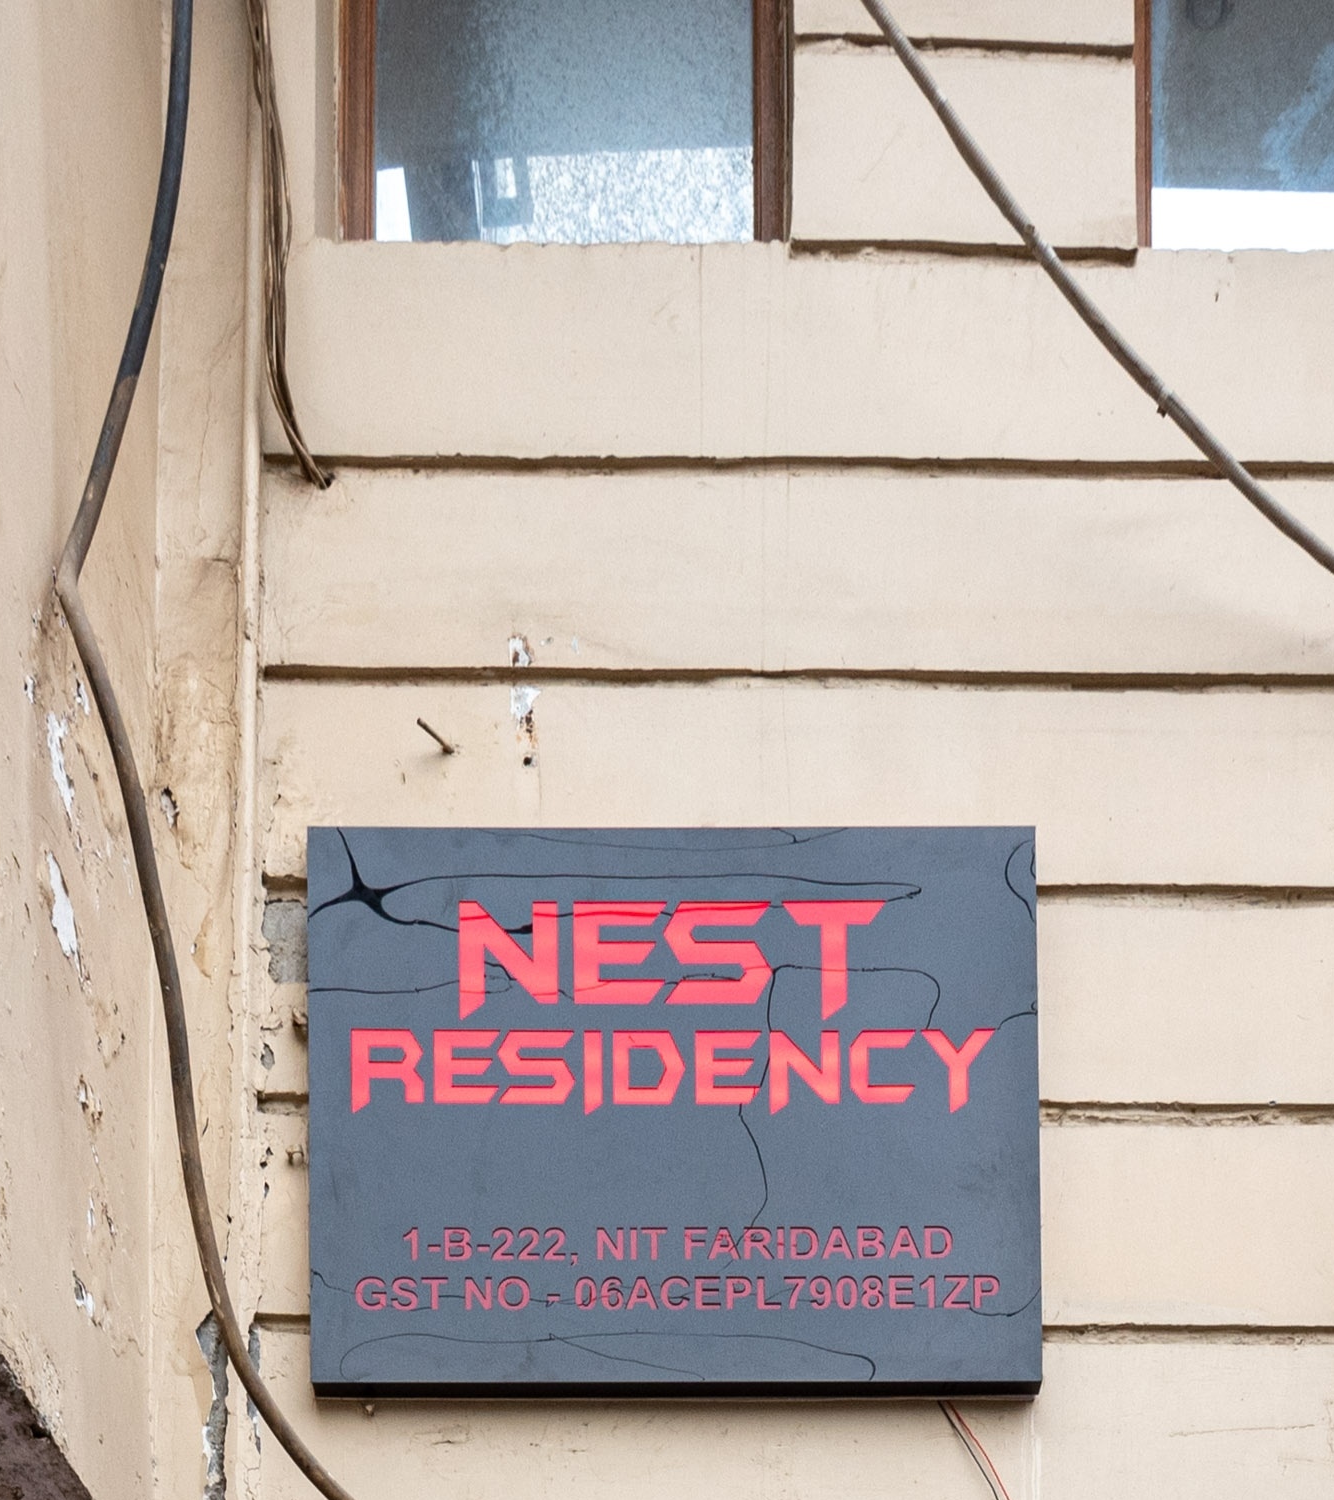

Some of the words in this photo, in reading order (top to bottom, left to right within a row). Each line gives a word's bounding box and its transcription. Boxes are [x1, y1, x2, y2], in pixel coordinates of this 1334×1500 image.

[457, 899, 888, 1021] NEST
[350, 1027, 997, 1116] RESIDENCY
[402, 1226, 579, 1266] 1-B-222,
[596, 1226, 668, 1261] NIT
[683, 1225, 955, 1261] FARIDABAD
[354, 1276, 449, 1311] GST
[464, 1276, 531, 1311] NO
[574, 1275, 1001, 1311] 06ACEPL7908E1ZP
